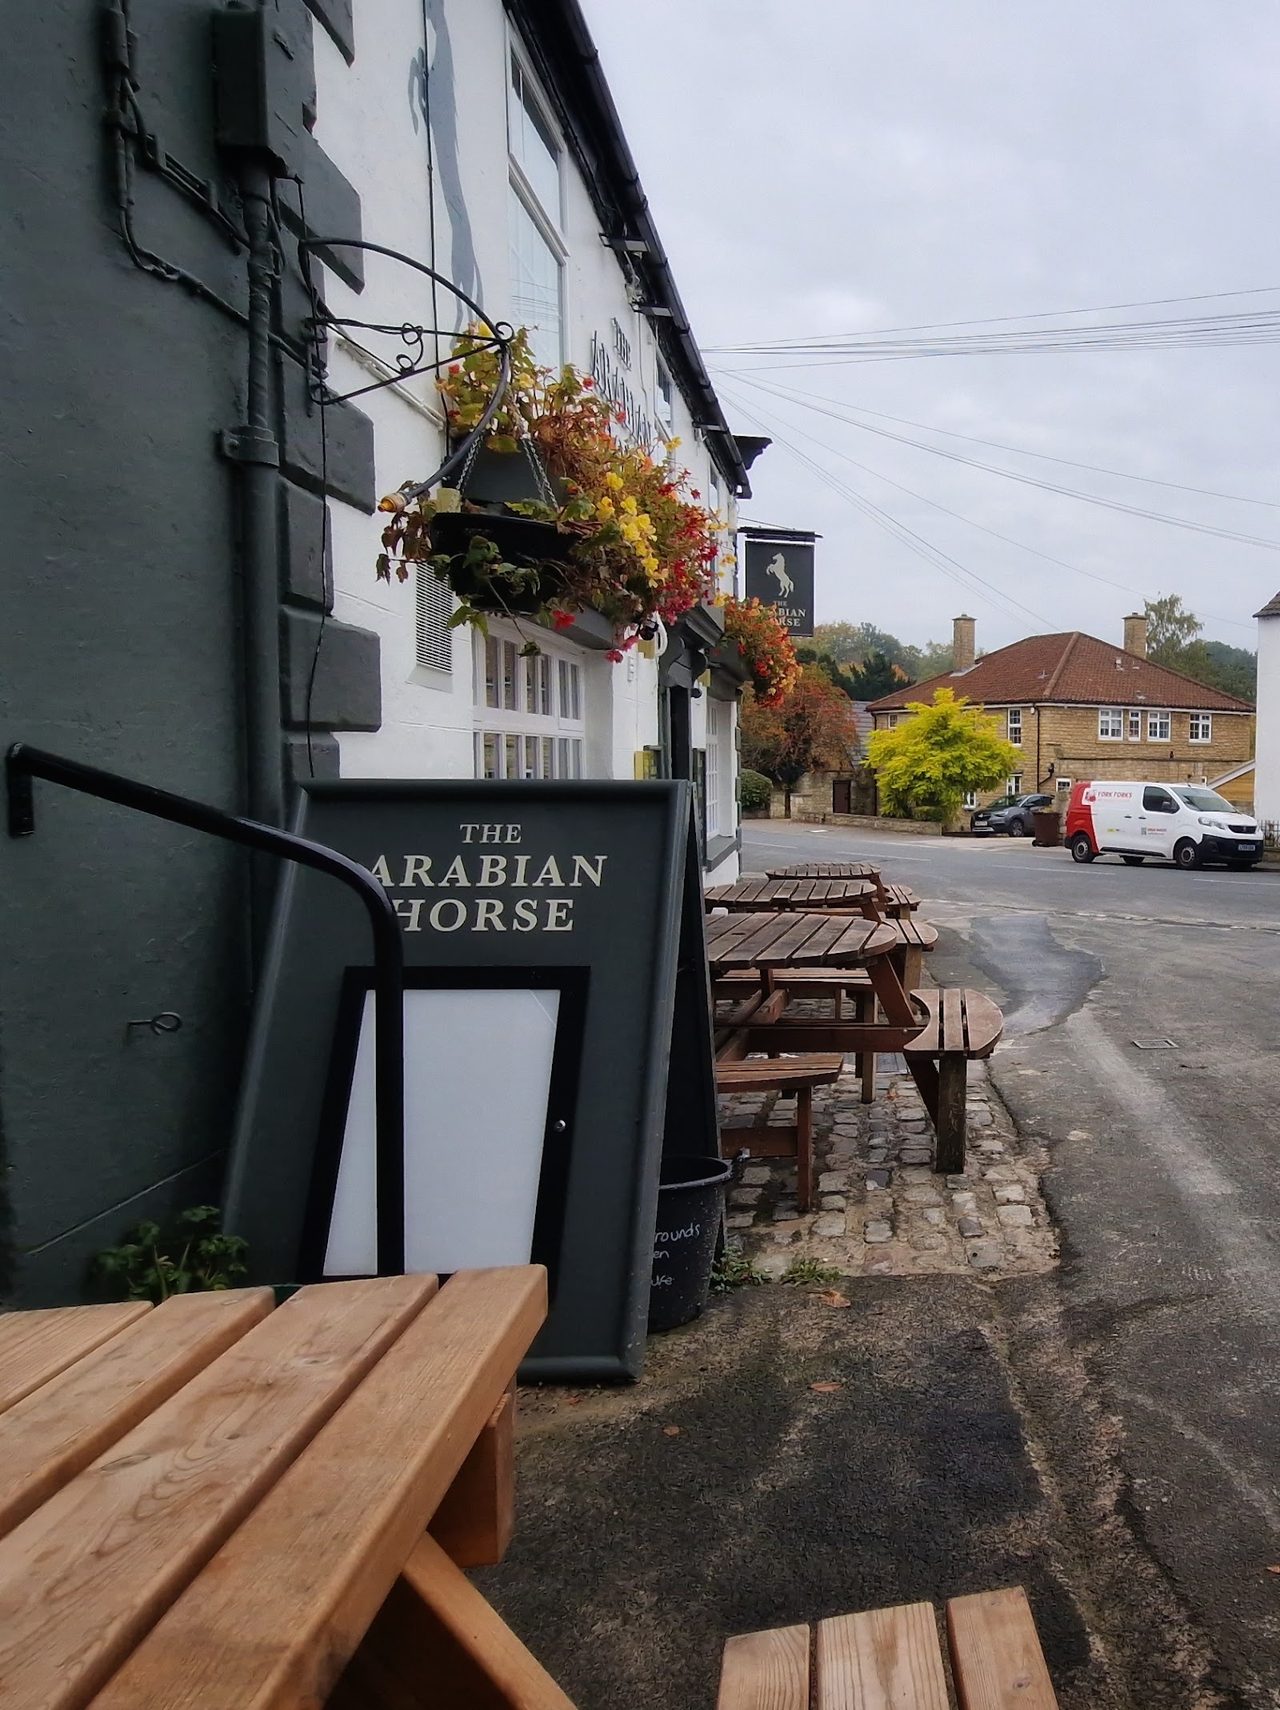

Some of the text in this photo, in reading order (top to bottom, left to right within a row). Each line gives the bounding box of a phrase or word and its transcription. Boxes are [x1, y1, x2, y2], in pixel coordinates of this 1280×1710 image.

[778, 608, 806, 617] BIAN
[459, 823, 522, 844] THE
[370, 854, 608, 887] ARABIAN
[392, 899, 575, 932] HORSE
[654, 1222, 701, 1243] rounds
